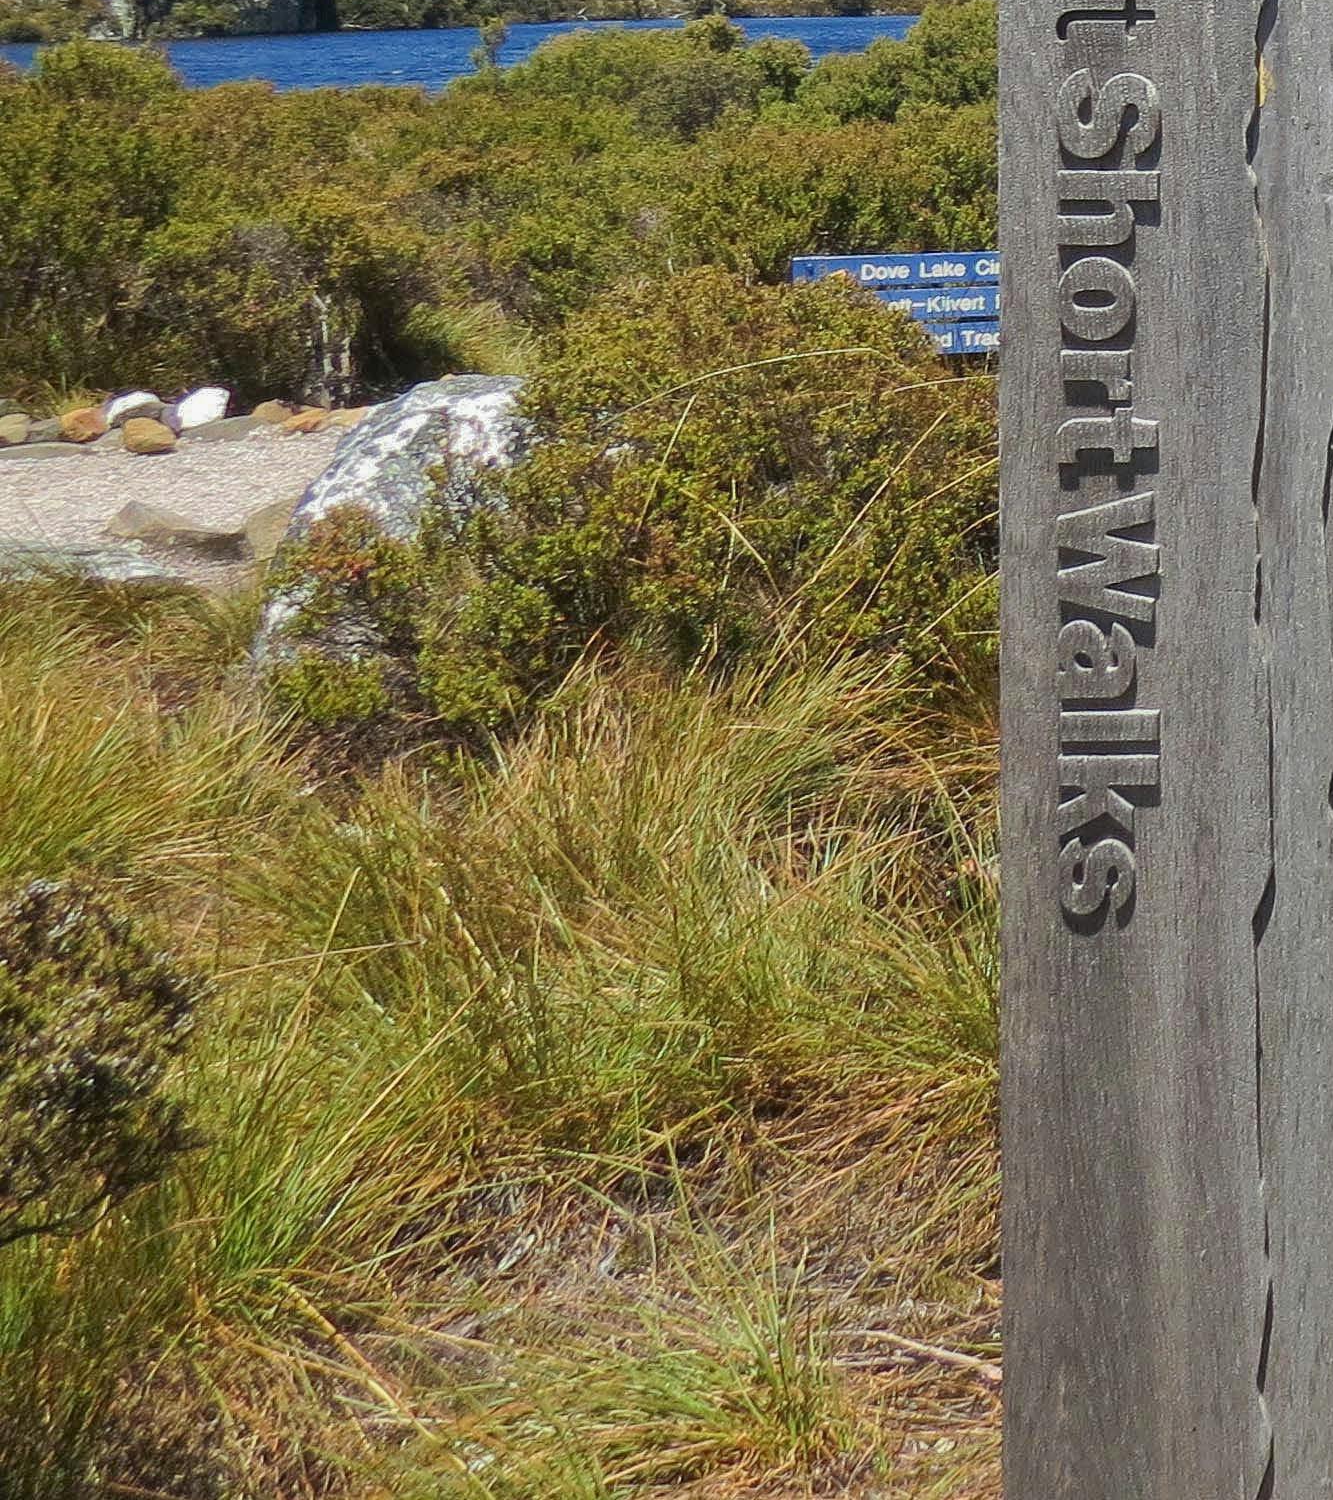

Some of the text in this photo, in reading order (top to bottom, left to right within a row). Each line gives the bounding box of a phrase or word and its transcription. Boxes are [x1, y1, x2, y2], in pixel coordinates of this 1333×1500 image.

[860, 263, 910, 281] Dove
[919, 260, 966, 278] Lake
[1055, 66, 1163, 484] Short
[1055, 491, 1163, 932] Walks
